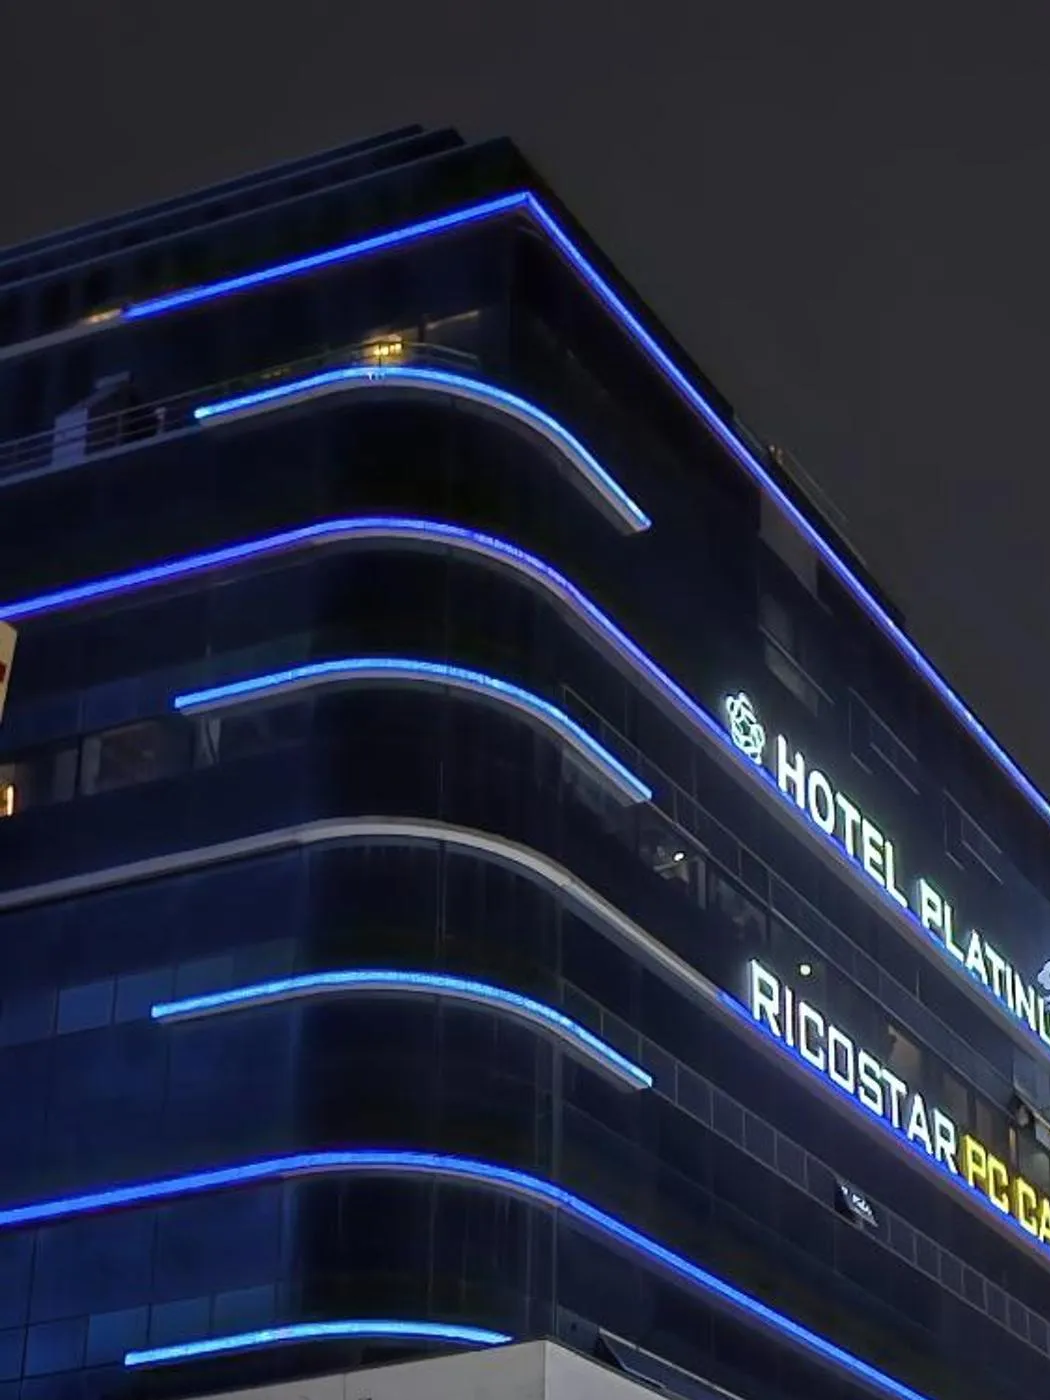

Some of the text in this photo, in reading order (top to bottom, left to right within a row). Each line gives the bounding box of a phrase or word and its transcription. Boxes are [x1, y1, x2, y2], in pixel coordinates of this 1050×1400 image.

[776, 735, 908, 909] HOTEL
[749, 958, 959, 1176] RICOSTAR
[961, 1134, 1010, 1213] PC
